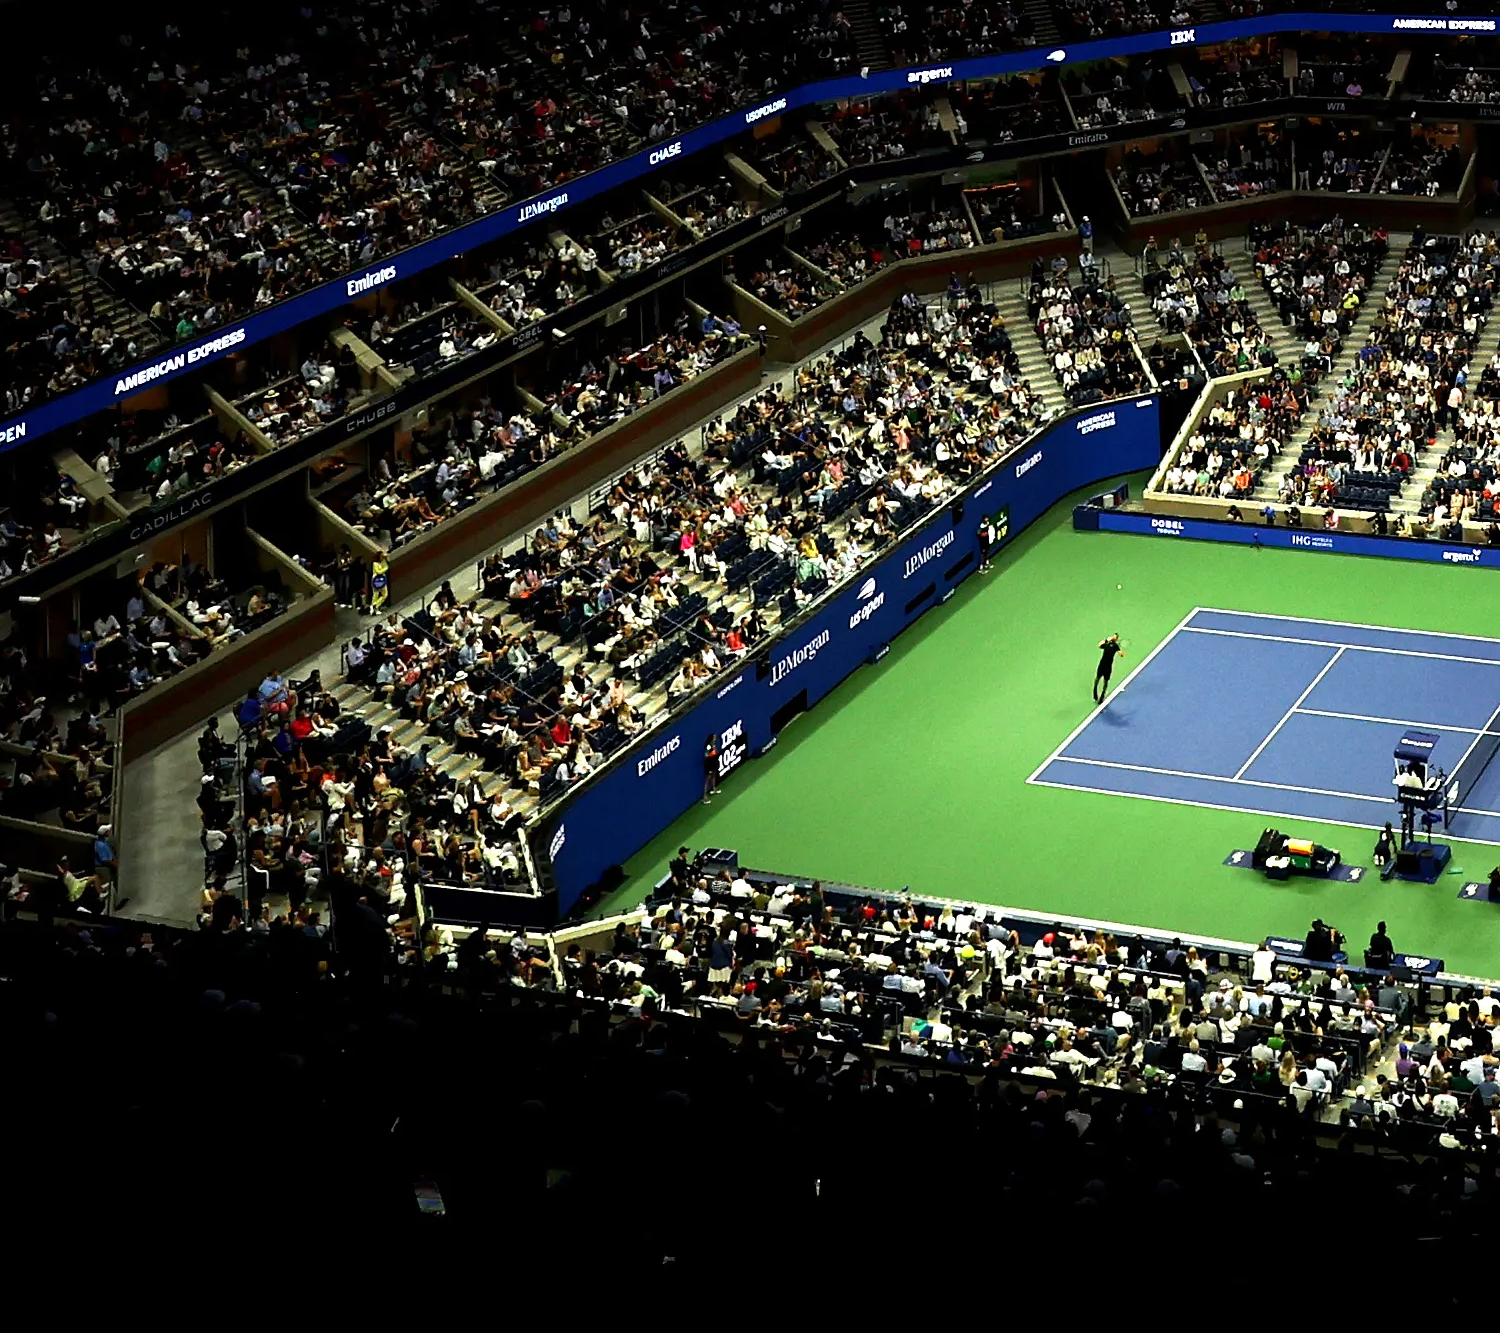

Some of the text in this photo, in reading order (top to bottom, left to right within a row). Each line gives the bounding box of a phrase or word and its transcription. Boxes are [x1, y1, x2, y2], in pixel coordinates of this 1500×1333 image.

[1170, 30, 1195, 45] IBM
[1393, 19, 1496, 31] AMERICAN EXPRESS
[907, 66, 953, 84] argenx
[745, 97, 787, 123] USOPEN.ORG
[1068, 132, 1109, 147] Emirates
[649, 141, 682, 165] CHASE
[517, 192, 569, 223] J.P.Morgan
[346, 264, 396, 297] Emirates
[114, 328, 246, 395] AMERICAN EXPRESS
[346, 401, 396, 432] CHUBB
[1076, 411, 1115, 430] AMERICAN
[1081, 420, 1116, 435] EXPRESS
[129, 492, 213, 541] CADILLAC
[1151, 518, 1184, 530] DOBEL
[1291, 534, 1311, 546] IHG
[902, 529, 955, 580] J.P.Morgan
[1443, 549, 1474, 562] argenx
[849, 591, 885, 629] us open
[769, 629, 830, 686] J.P.Morgan
[721, 719, 743, 749] IBM
[637, 735, 681, 777] Emirates
[718, 744, 737, 771] 102
